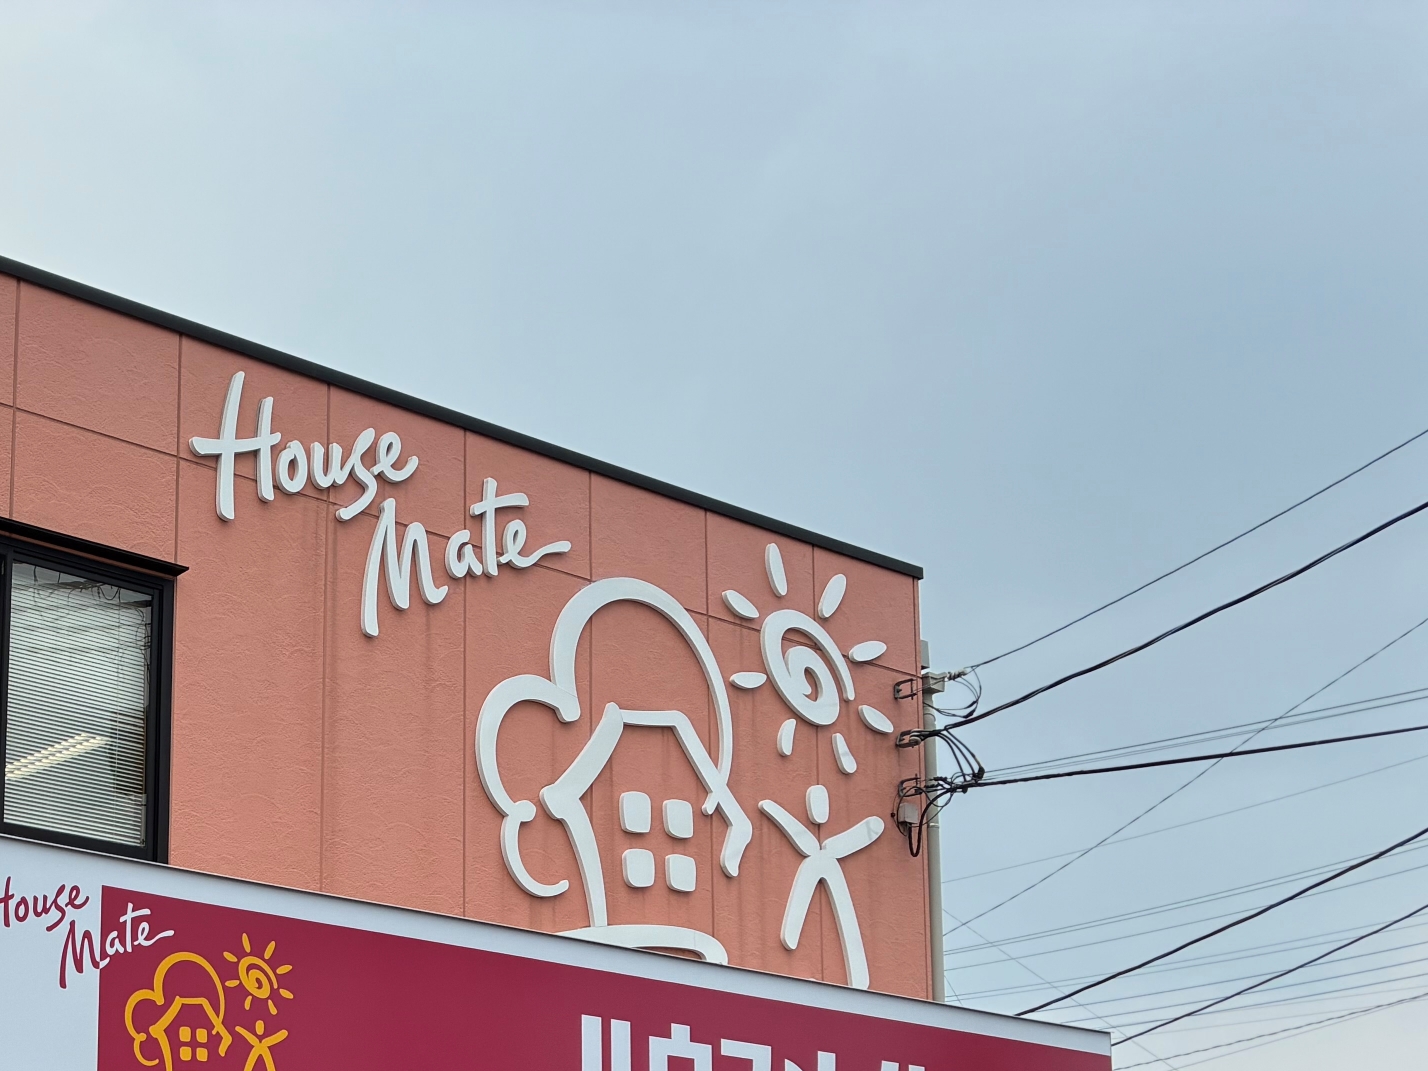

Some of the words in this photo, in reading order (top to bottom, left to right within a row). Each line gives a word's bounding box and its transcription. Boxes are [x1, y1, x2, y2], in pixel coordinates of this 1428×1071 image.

[189, 370, 419, 522] House
[360, 477, 572, 638] Mate
[58, 902, 175, 989] Mate
